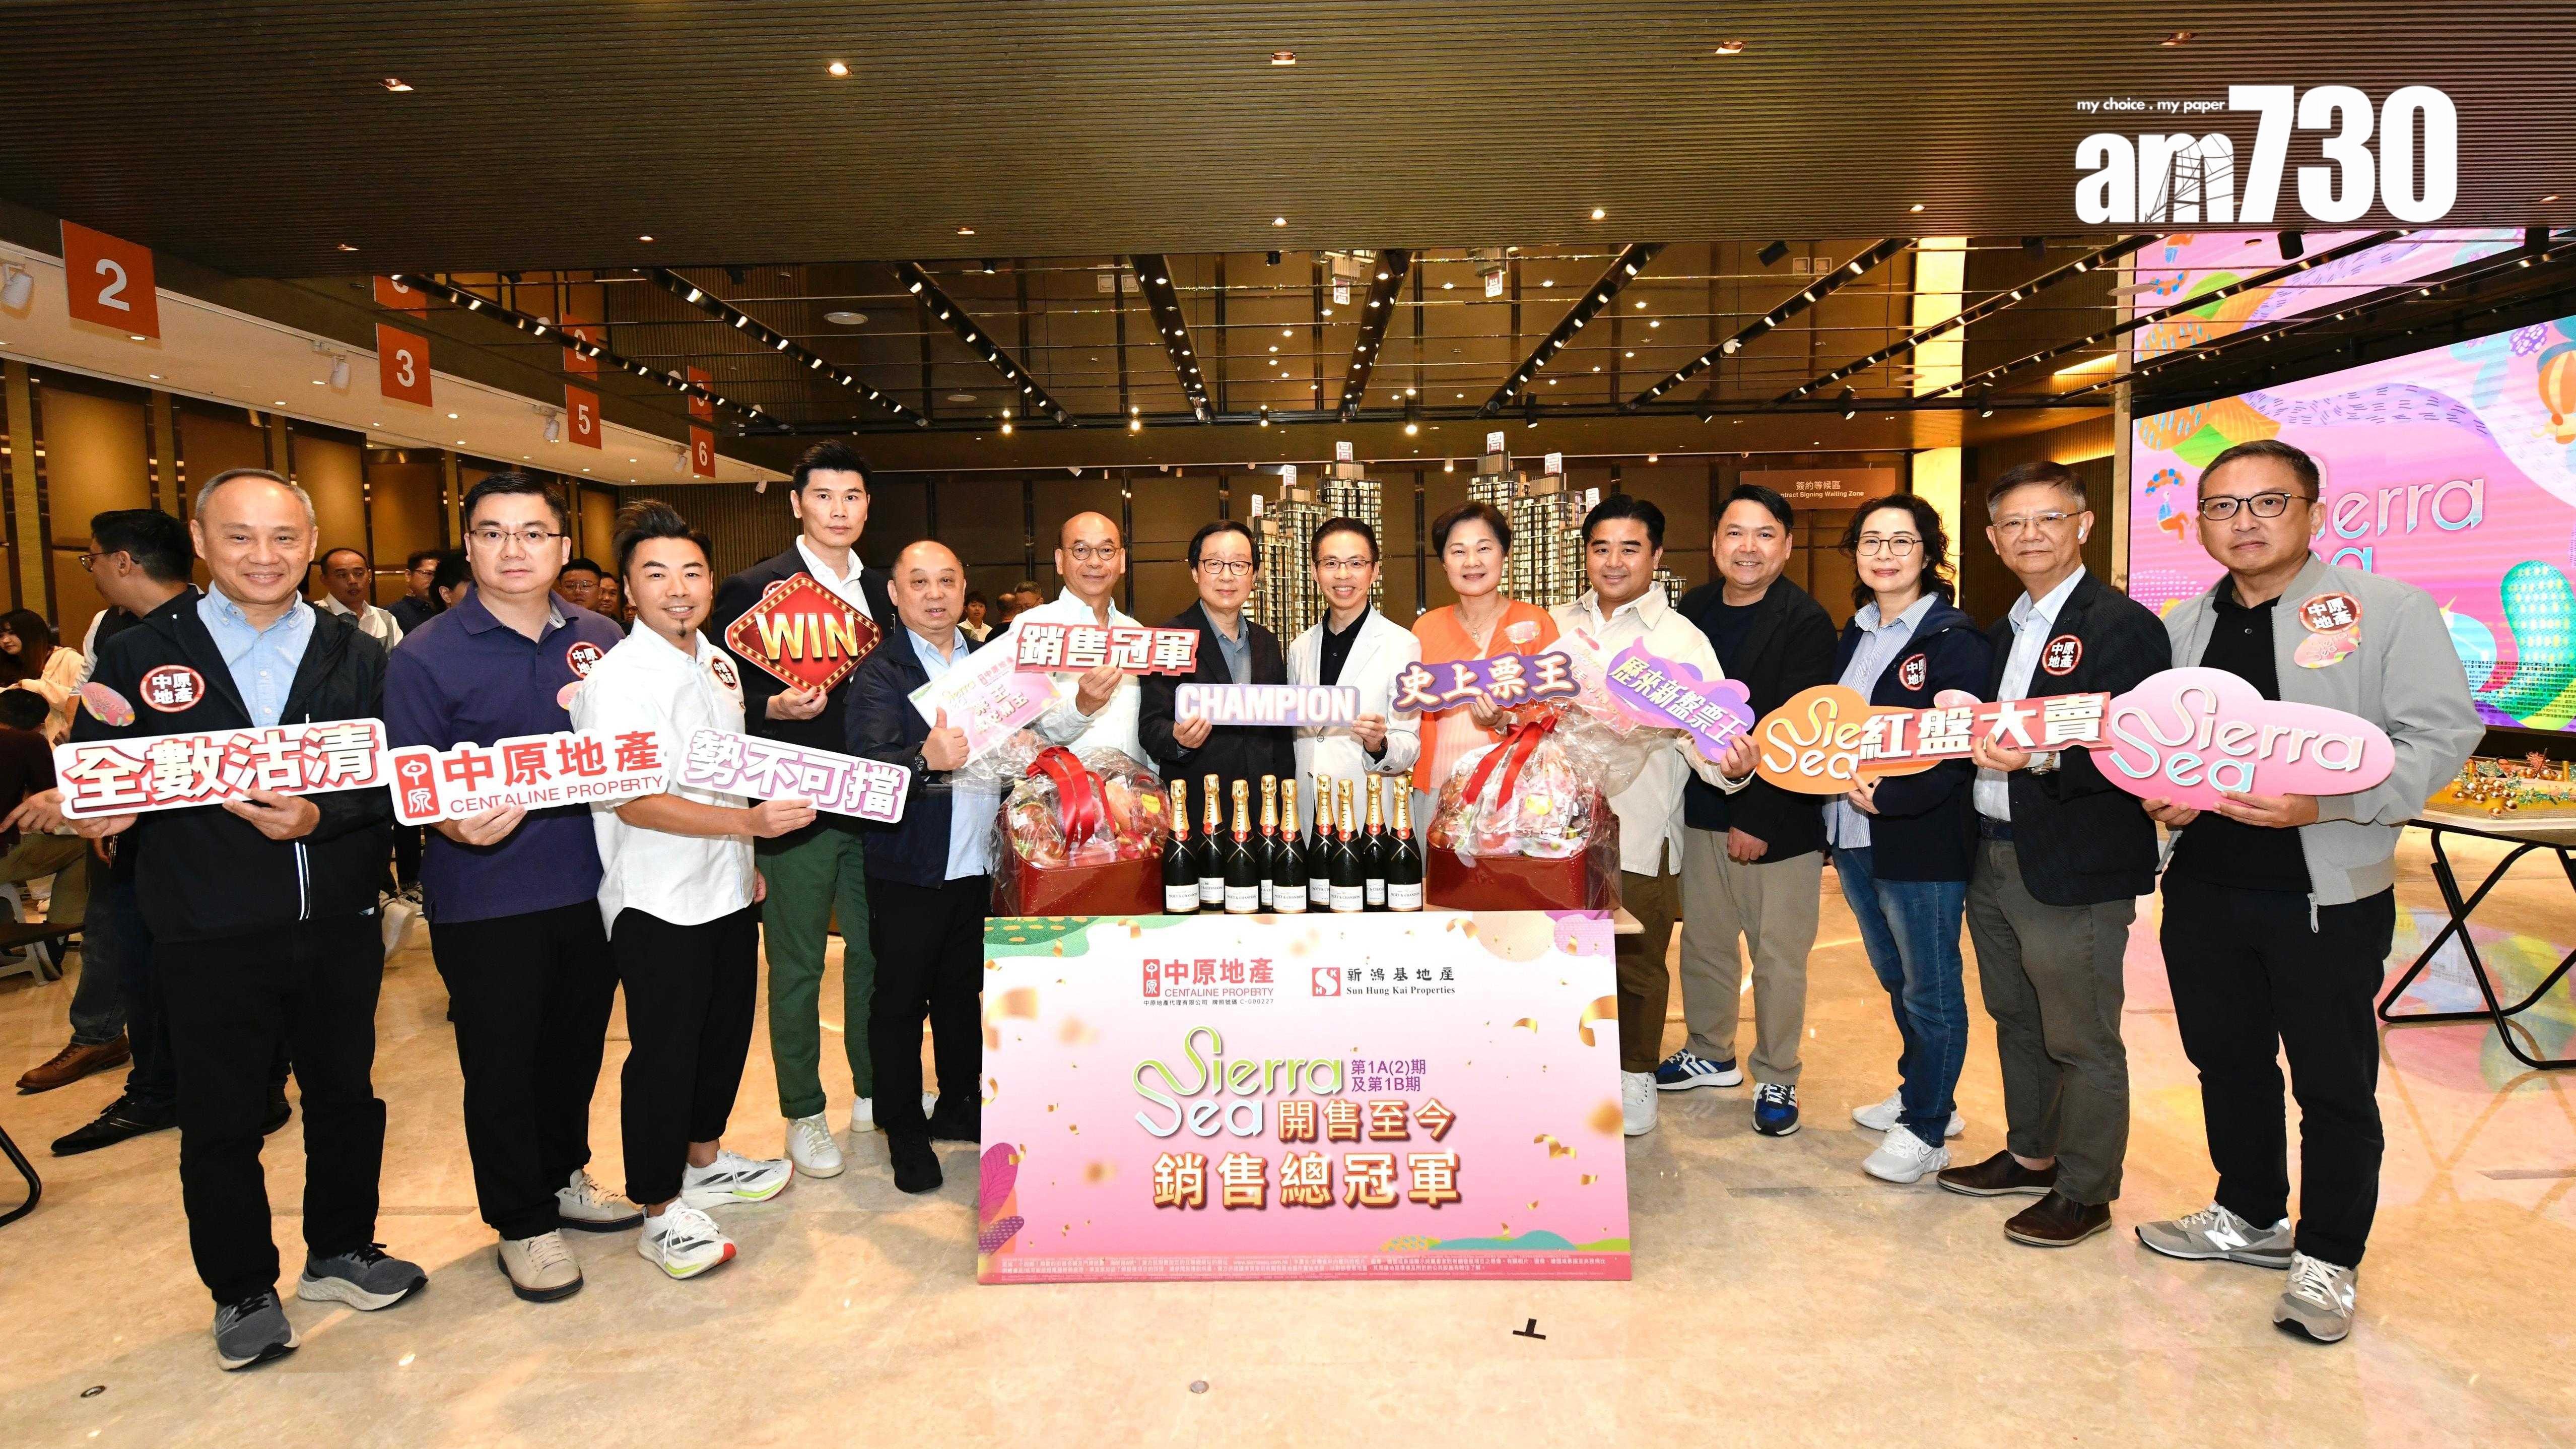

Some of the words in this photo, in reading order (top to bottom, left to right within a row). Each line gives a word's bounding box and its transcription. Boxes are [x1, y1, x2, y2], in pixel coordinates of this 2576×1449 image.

[95, 258, 130, 311] 2
[396, 349, 415, 387] 3
[578, 404, 590, 435] 5
[698, 441, 708, 466] 6
[1796, 481, 1841, 490] 簽約等候區
[2310, 455, 2484, 541] erra
[2307, 597, 2347, 616] 中原
[2313, 610, 2353, 629] 地產
[755, 613, 858, 660] WIN
[1019, 626, 1196, 670] 銷售冠軍
[2051, 642, 2076, 655] 中原
[152, 673, 192, 689] 中原
[577, 661, 592, 674] 地
[1399, 655, 1574, 706] 史上票王
[2048, 655, 2073, 668] 地產
[153, 687, 193, 704] 地產
[1178, 686, 1355, 722] CHAMPION
[1608, 656, 1748, 747] 歷來新盤票王
[1783, 697, 1861, 749] Sie
[1860, 694, 2102, 760] 紅盤大賣
[2148, 685, 2364, 771] Sierra
[64, 724, 377, 811] 全數沽清
[442, 731, 661, 793] 中原地產
[1763, 716, 1859, 779] Sea
[2111, 715, 2256, 792] Sea
[450, 788, 560, 814] CENTALINE
[567, 775, 663, 800] PROPERTY
[687, 731, 903, 818] 勢不可擋
[1165, 958, 1274, 985] 中原地產
[1165, 989, 1219, 997] CENTALINE
[1223, 987, 1274, 996] PROPERTY
[1347, 986, 1363, 995] Sun
[1366, 986, 1389, 996] Hung
[1393, 986, 1407, 995] Kai
[1411, 985, 1455, 996] Properties
[1159, 1025, 1343, 1095] Sierra
[1351, 1059, 1426, 1076] 第1A(2)期
[1133, 1063, 1263, 1137] Sea
[1351, 1076, 1421, 1092] 及第1B期
[1278, 1098, 1455, 1142] 開售至今
[1153, 1151, 1460, 1208] 銷售總冠軍
